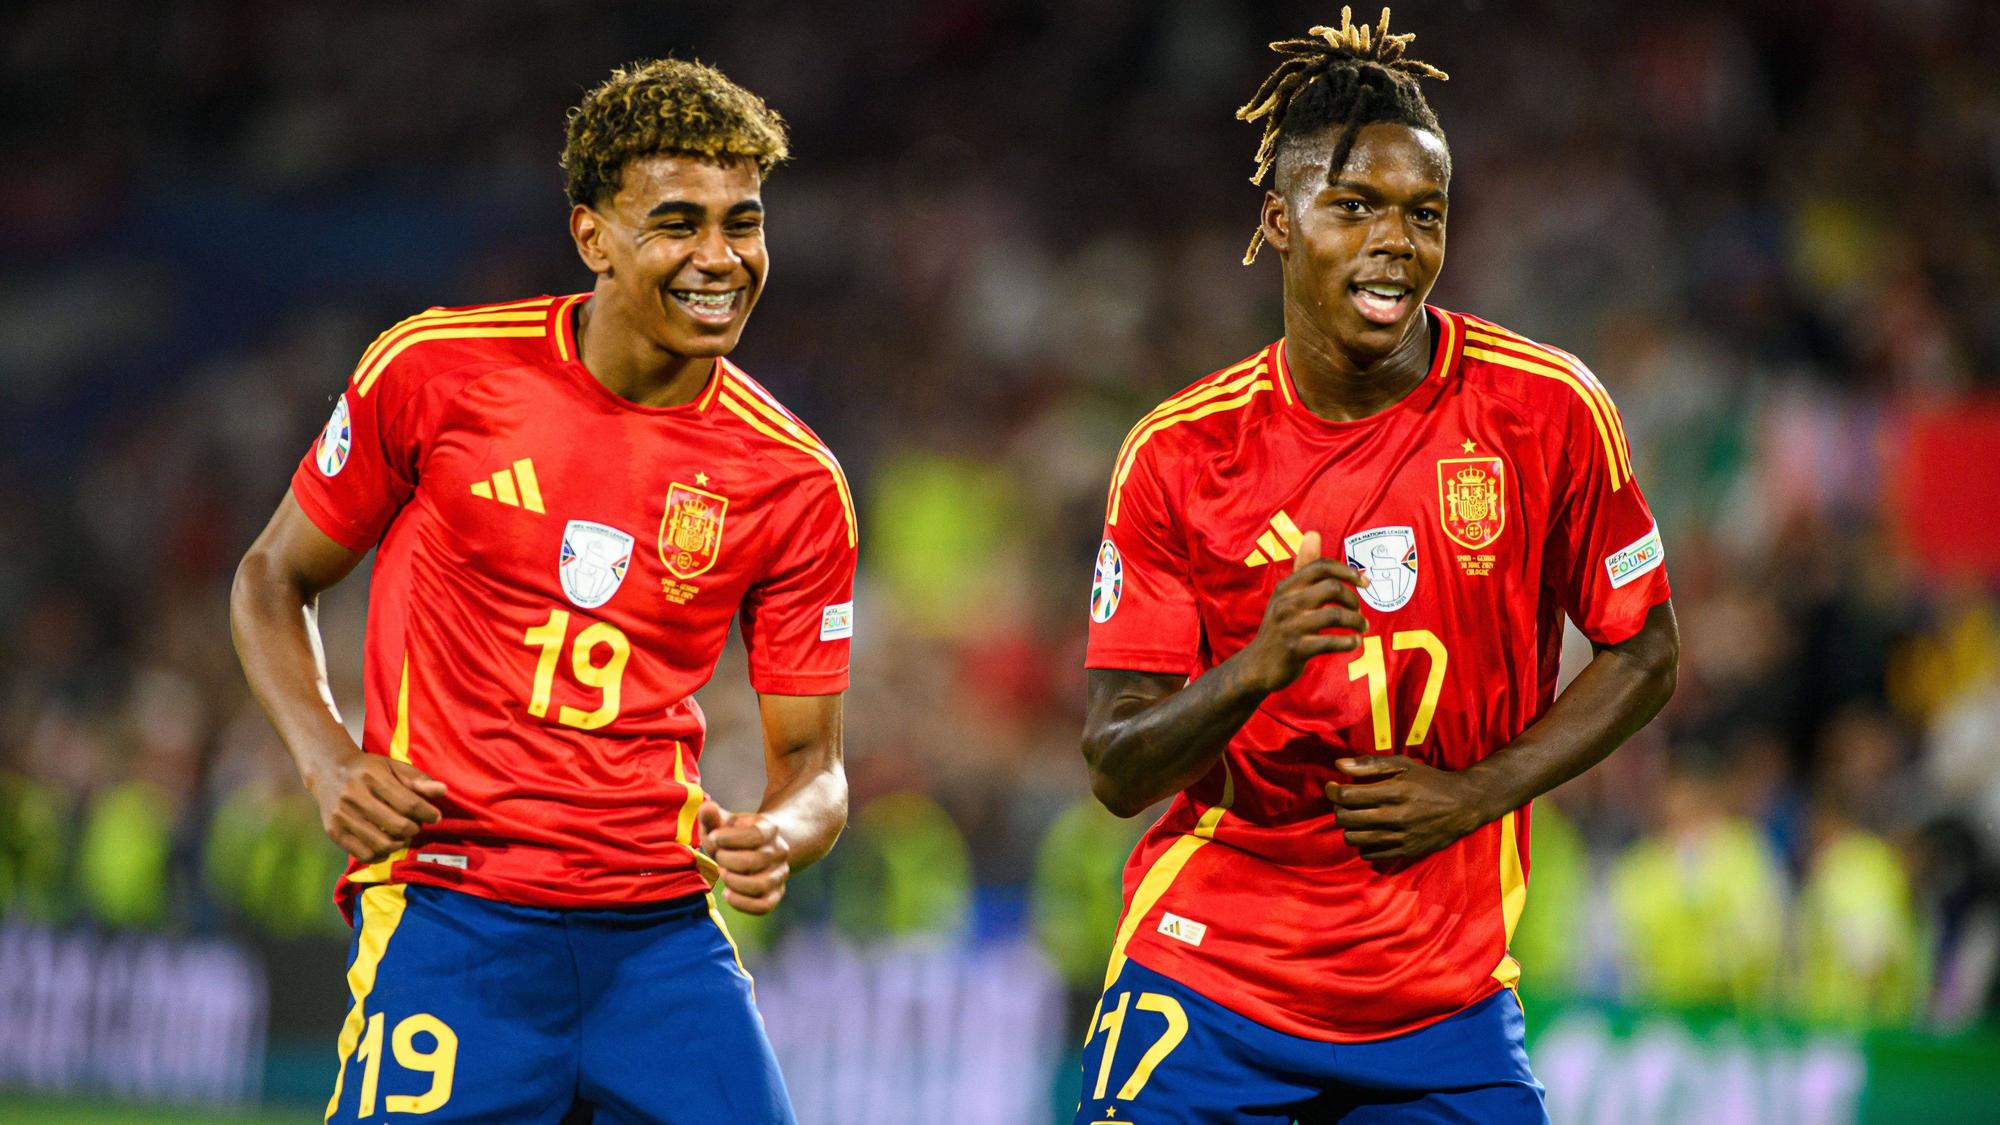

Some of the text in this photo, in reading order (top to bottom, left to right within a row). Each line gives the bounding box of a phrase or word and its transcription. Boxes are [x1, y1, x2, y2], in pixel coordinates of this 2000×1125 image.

[1608, 552, 1628, 567] UEFA
[523, 608, 632, 731] 19
[1347, 629, 1449, 751] 17
[357, 1012, 459, 1119] 19
[1093, 991, 1189, 1101] 17
